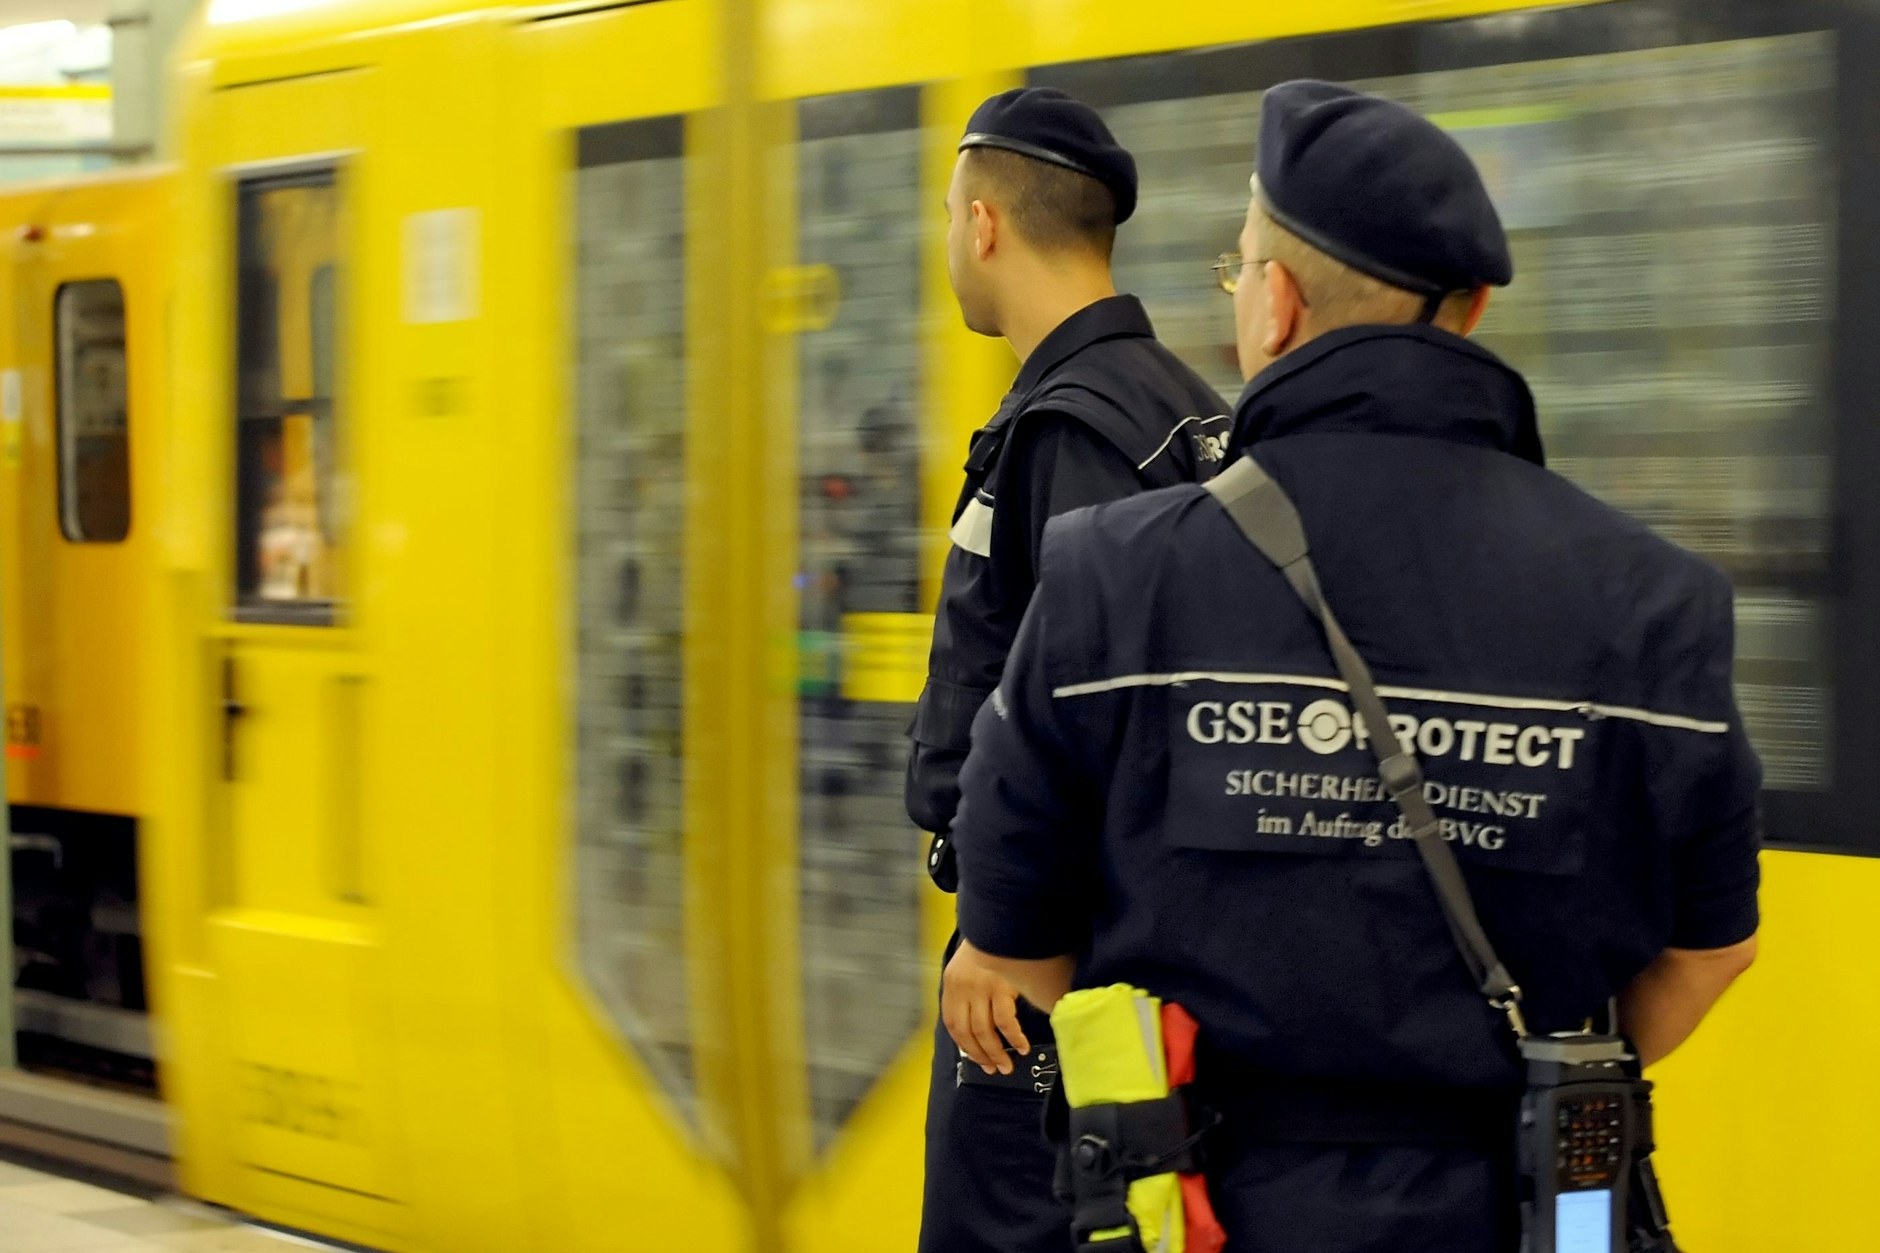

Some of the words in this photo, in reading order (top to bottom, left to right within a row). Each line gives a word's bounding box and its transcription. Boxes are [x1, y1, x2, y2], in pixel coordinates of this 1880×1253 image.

[1187, 701, 1293, 744] GSE
[1225, 769, 1547, 818] SICHERHEIDIENST
[1257, 808, 1292, 835] im
[1439, 818, 1506, 851] BVG
